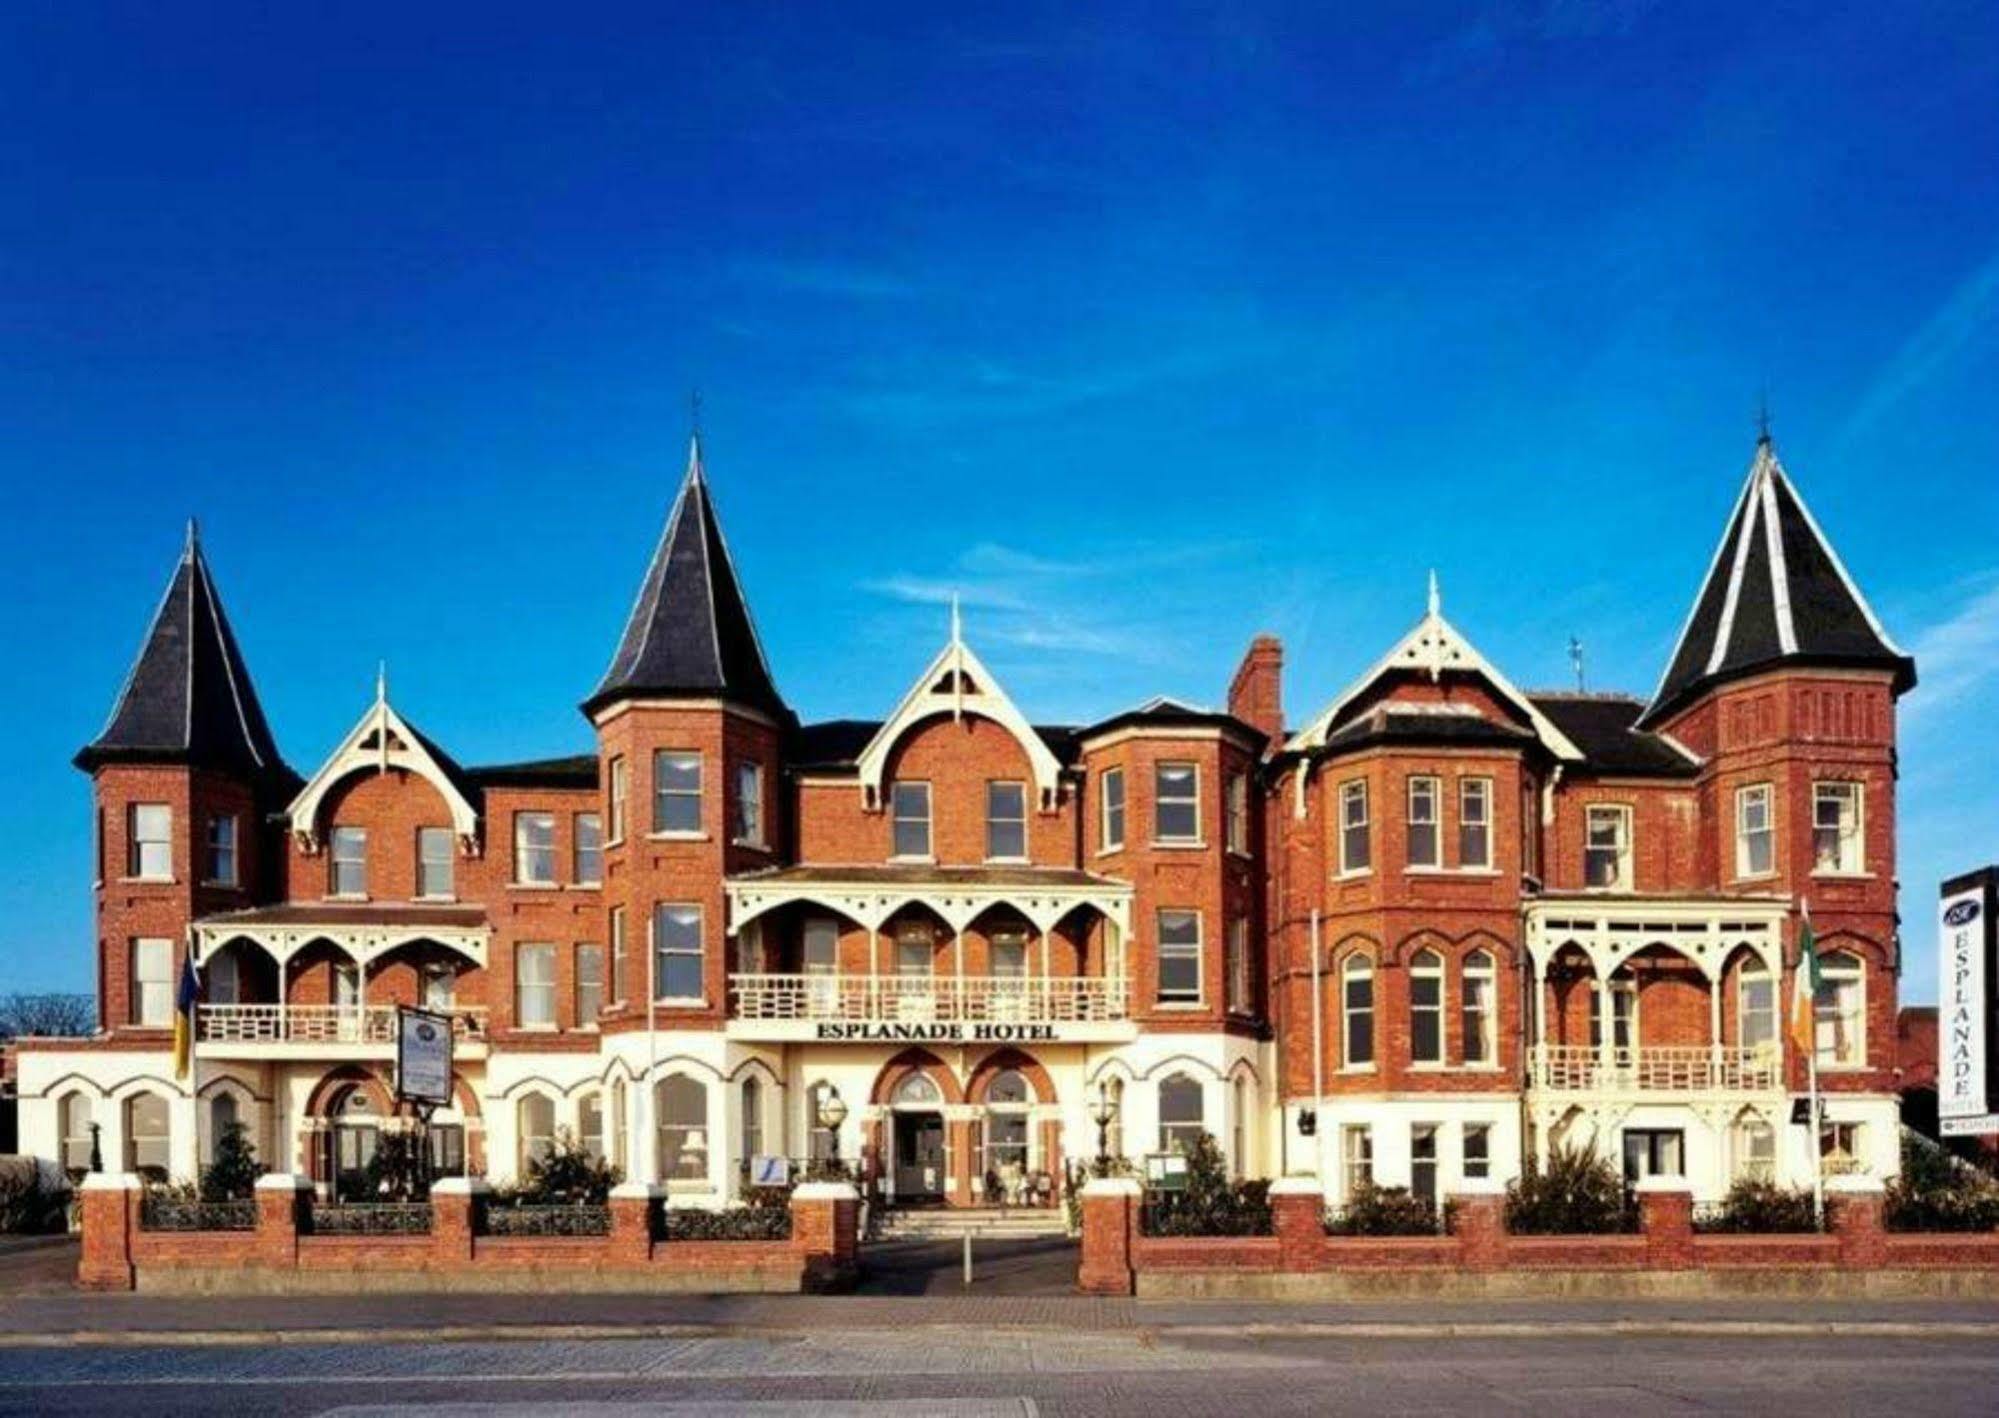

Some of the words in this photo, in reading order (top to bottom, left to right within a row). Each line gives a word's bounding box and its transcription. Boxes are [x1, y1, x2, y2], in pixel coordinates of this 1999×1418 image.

[817, 1023, 963, 1040] ESPLANADE
[974, 1023, 1060, 1040] HOTEL
[1954, 931, 1970, 1096] ESPLANADE
